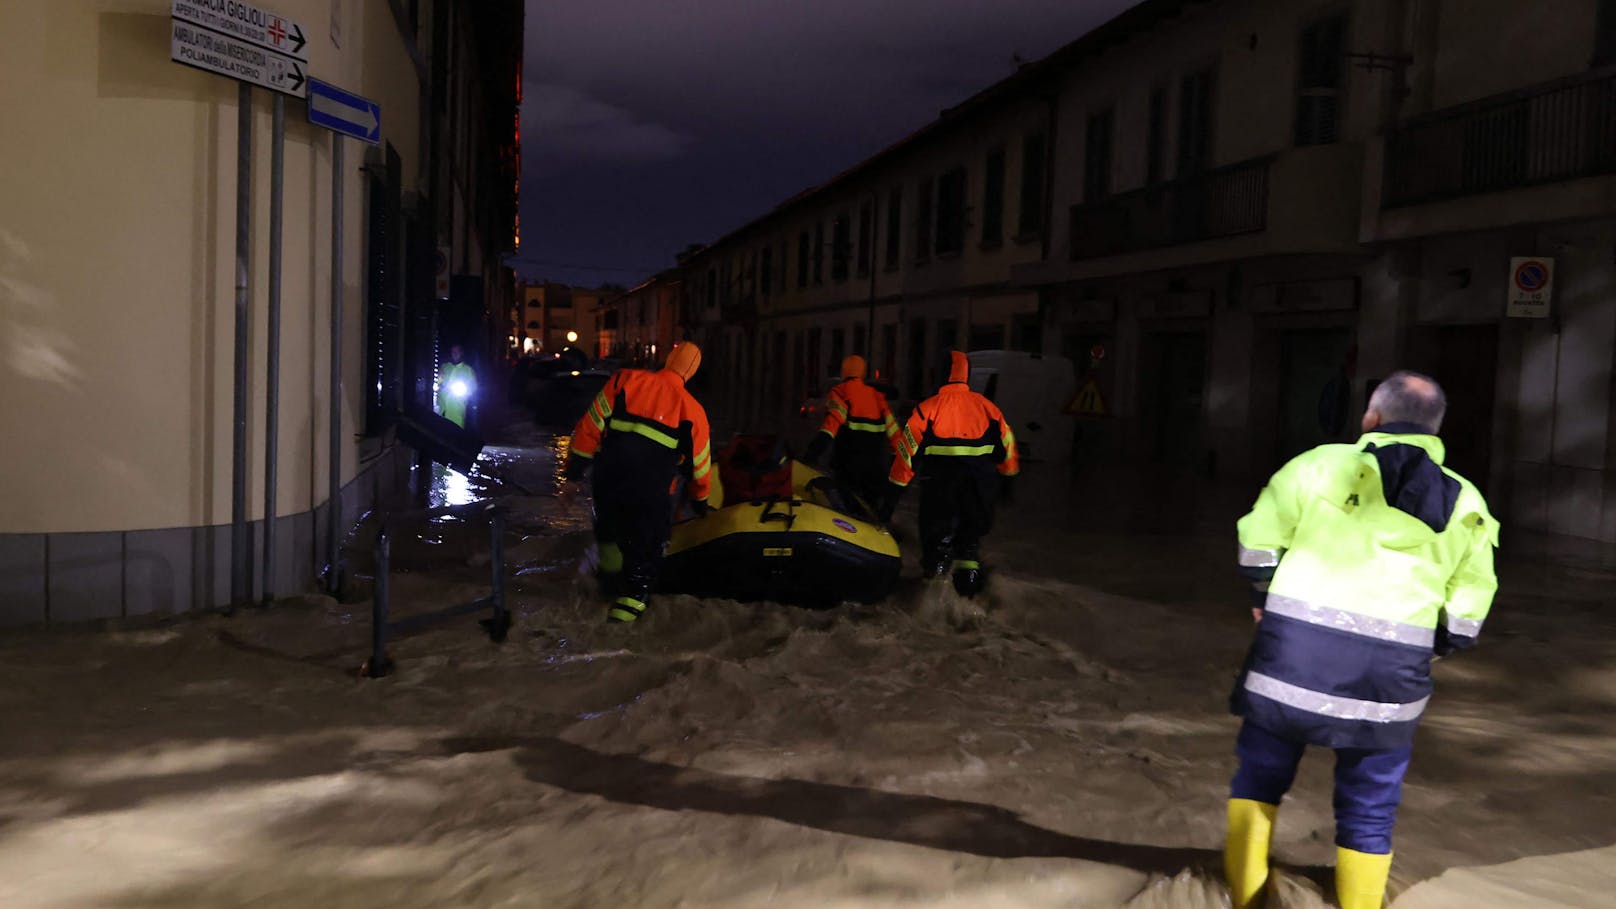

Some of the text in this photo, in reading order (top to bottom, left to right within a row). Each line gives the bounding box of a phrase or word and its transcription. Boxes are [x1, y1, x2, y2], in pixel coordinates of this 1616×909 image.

[175, 3, 200, 18] APERTA
[187, 0, 266, 28] ACIA GIGLIOLI
[180, 46, 260, 79] POLIAMBULATORIO
[227, 41, 266, 66] MISERICORDIA
